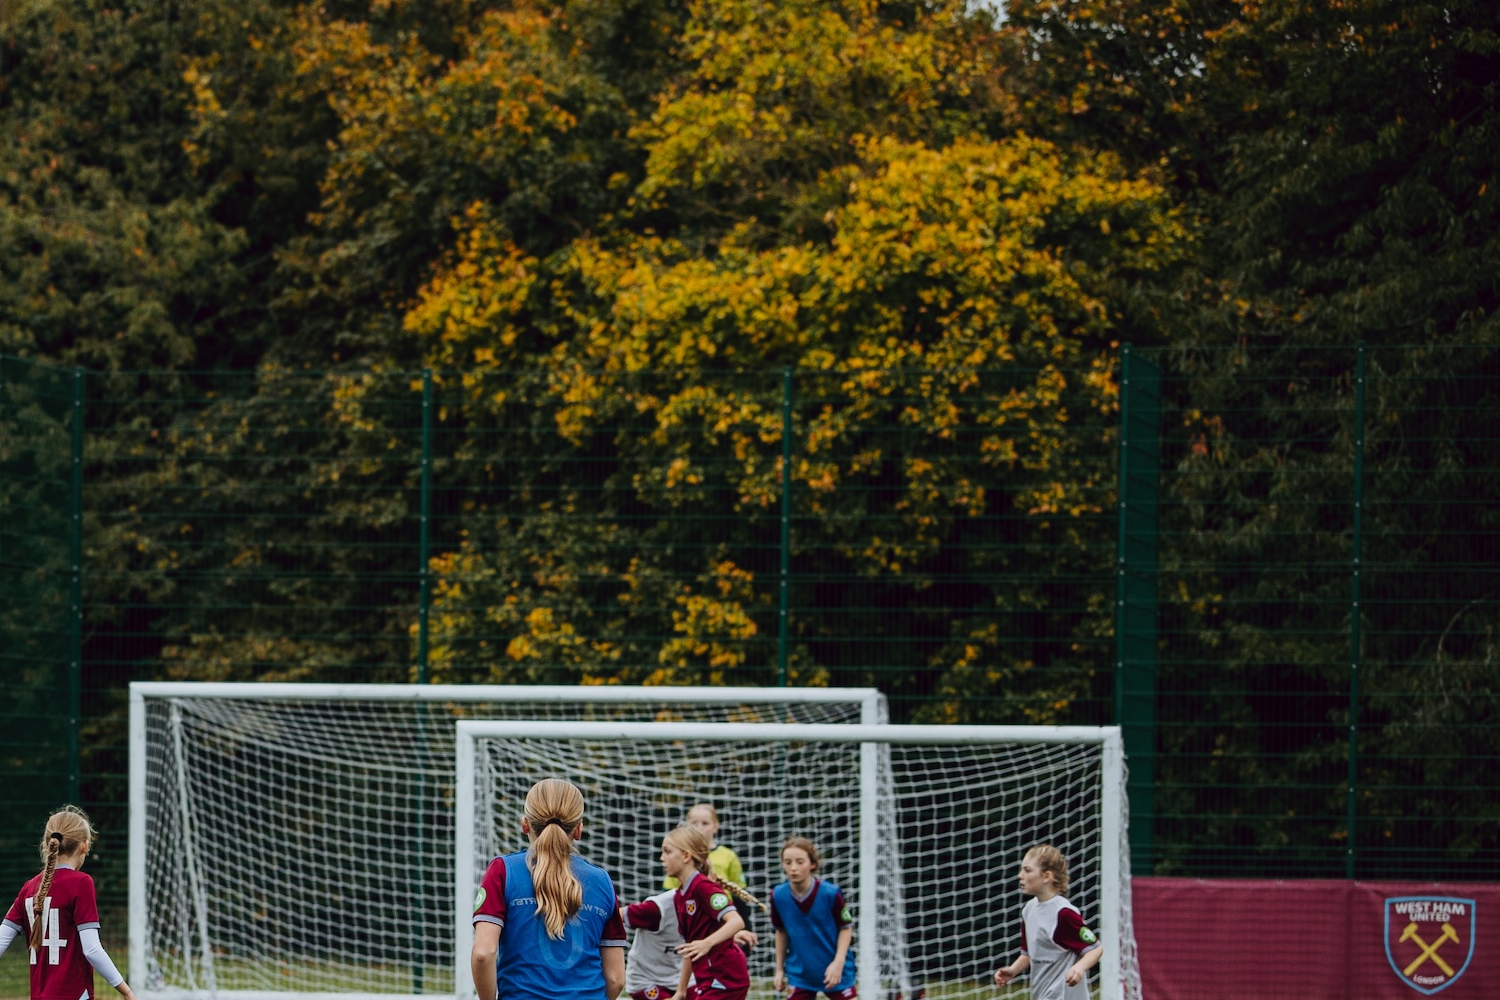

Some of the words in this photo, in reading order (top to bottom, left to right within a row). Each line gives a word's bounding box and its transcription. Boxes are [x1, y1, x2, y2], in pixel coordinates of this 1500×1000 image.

[1395, 901, 1430, 914] WEST
[1433, 902, 1465, 915] HAM
[1409, 912, 1450, 922] UNITED
[25, 896, 67, 965] 14
